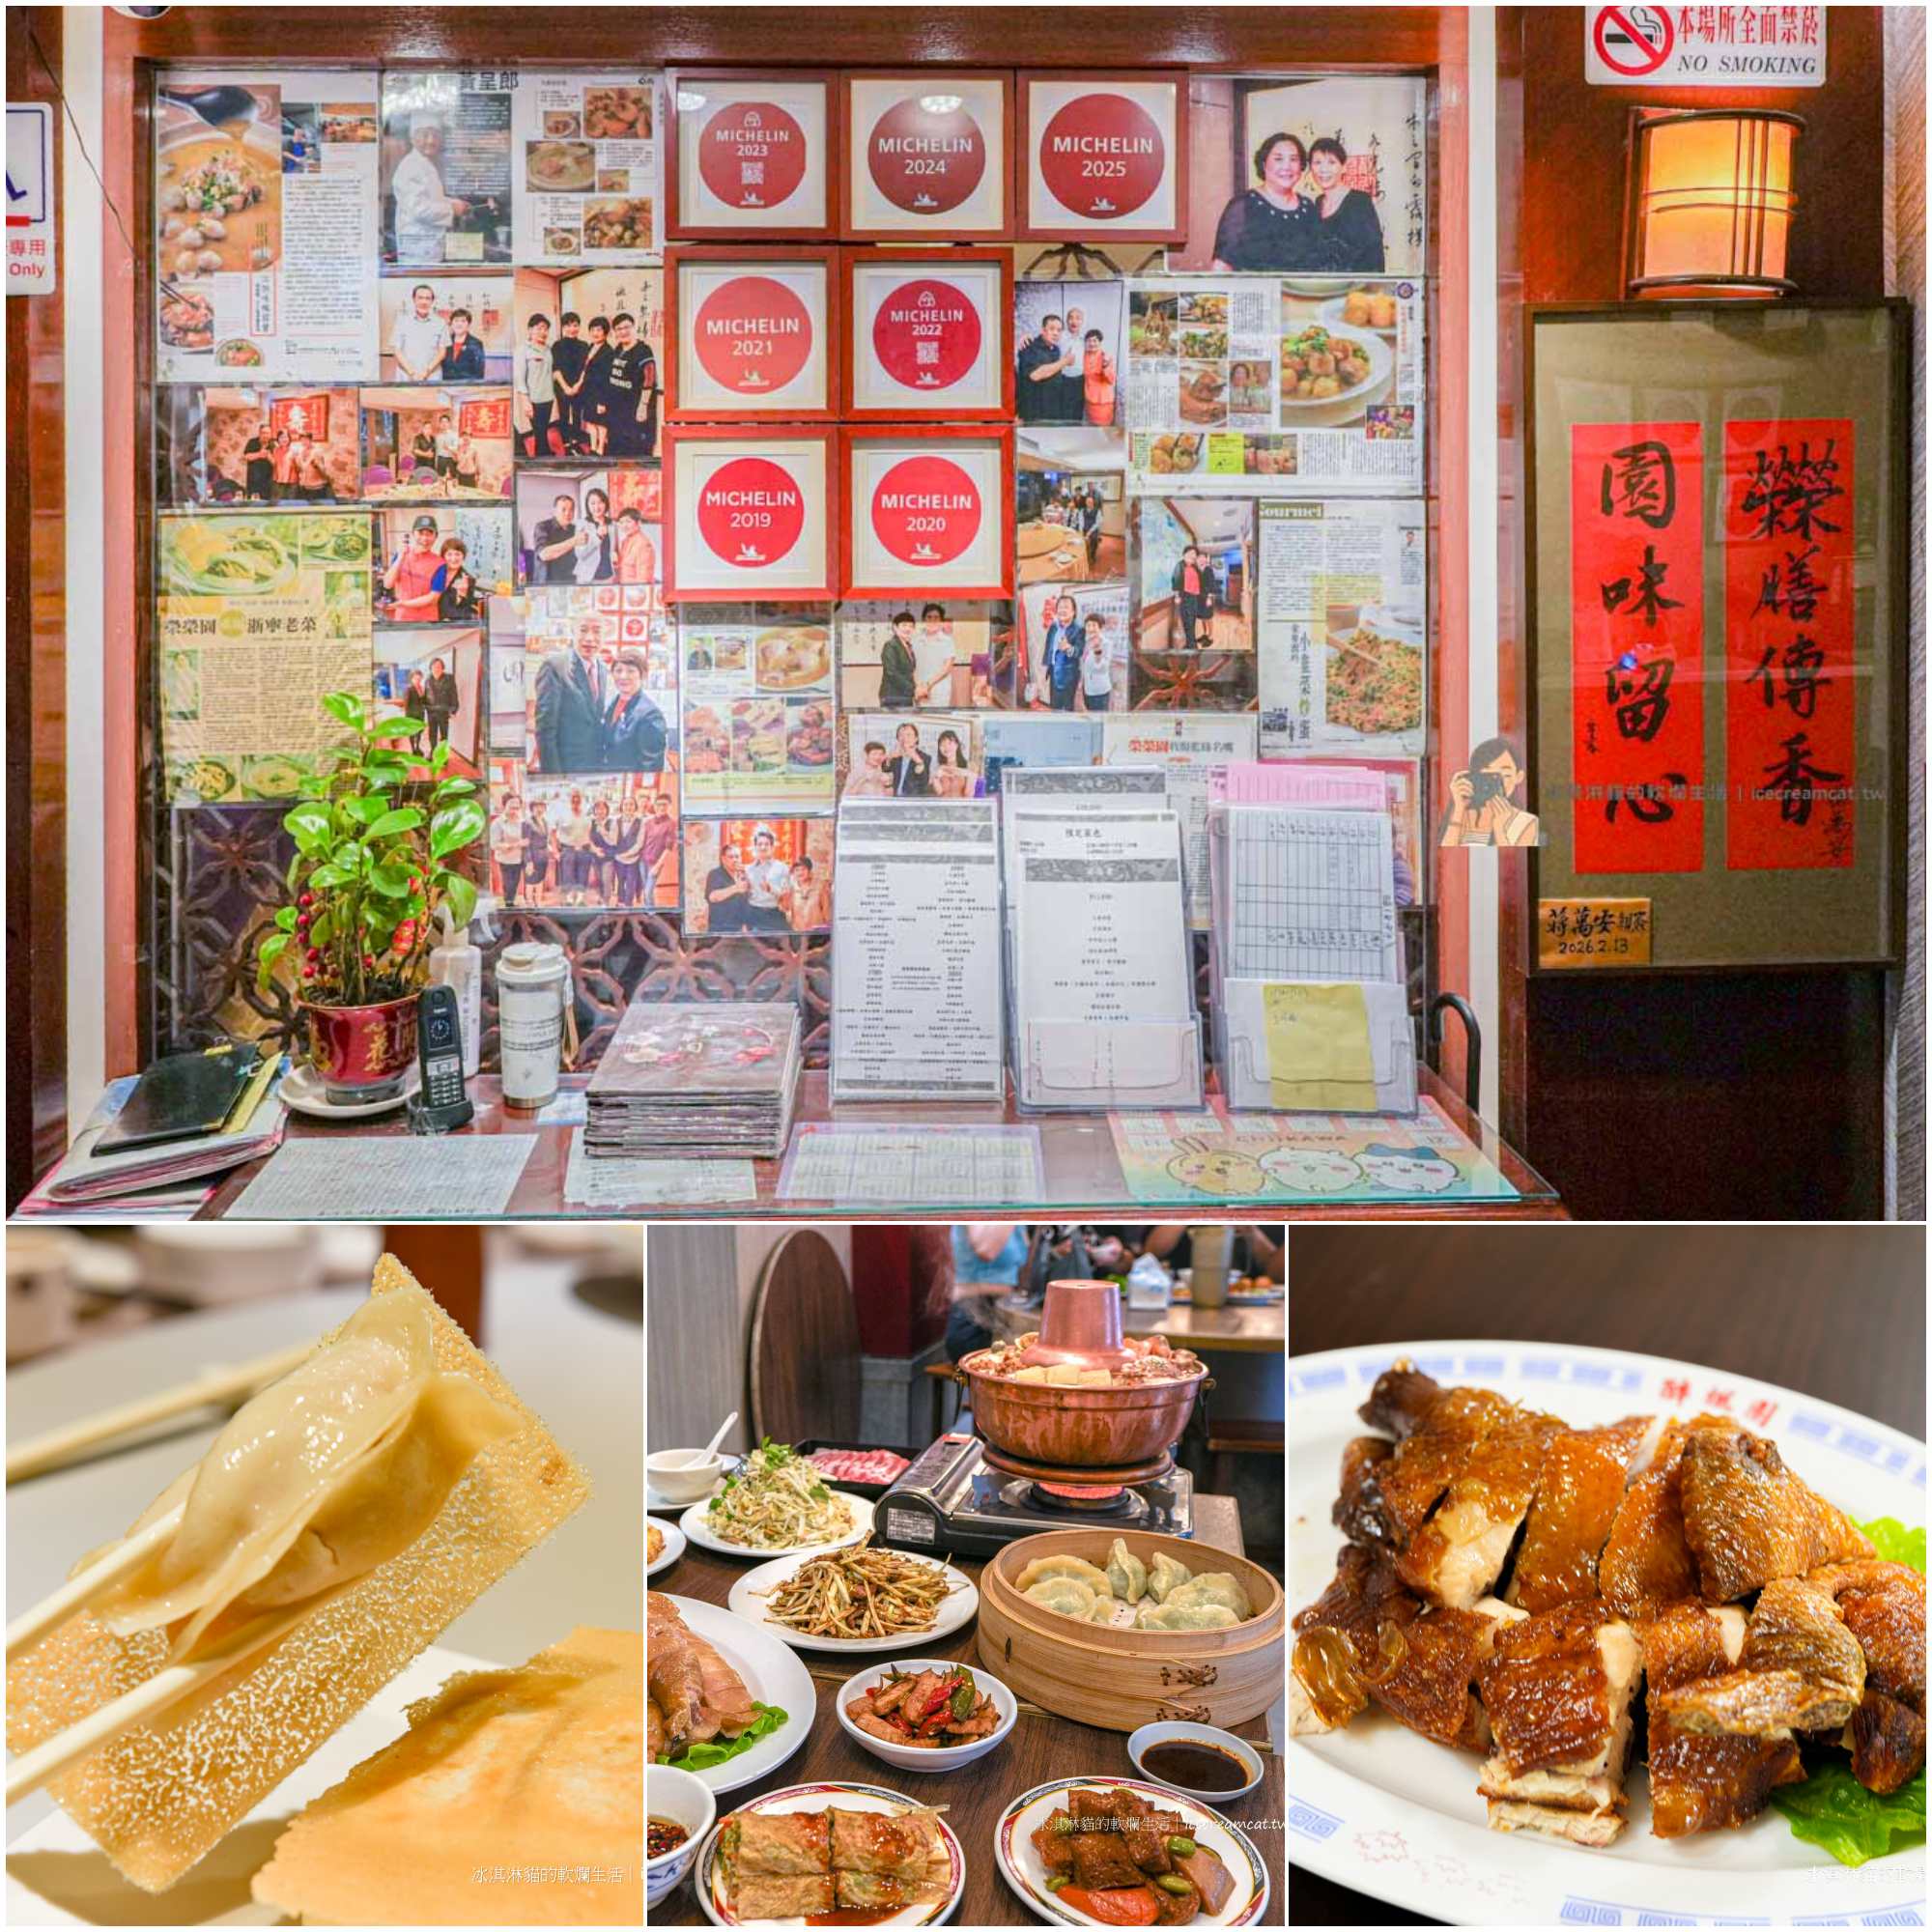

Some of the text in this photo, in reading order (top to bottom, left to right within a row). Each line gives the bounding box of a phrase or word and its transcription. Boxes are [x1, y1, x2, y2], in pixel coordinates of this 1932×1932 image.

[1677, 55, 1817, 74] NO SMOKING
[716, 129, 790, 142] MICHELIN
[736, 144, 769, 156] 2023
[878, 138, 973, 153] MICHELIN
[1053, 136, 1153, 153] MICHELIN
[904, 158, 946, 175] 2024
[1081, 160, 1127, 177] 2025
[9, 263, 45, 278] Only
[890, 309, 963, 323] MICHELIN
[706, 317, 800, 335] MICHELIN
[911, 323, 943, 335] 2022
[732, 339, 773, 355] 2021
[706, 490, 796, 507] MICHELIN
[881, 494, 972, 510] MICHELIN
[730, 512, 771, 528] 2019
[905, 516, 947, 532] 2020
